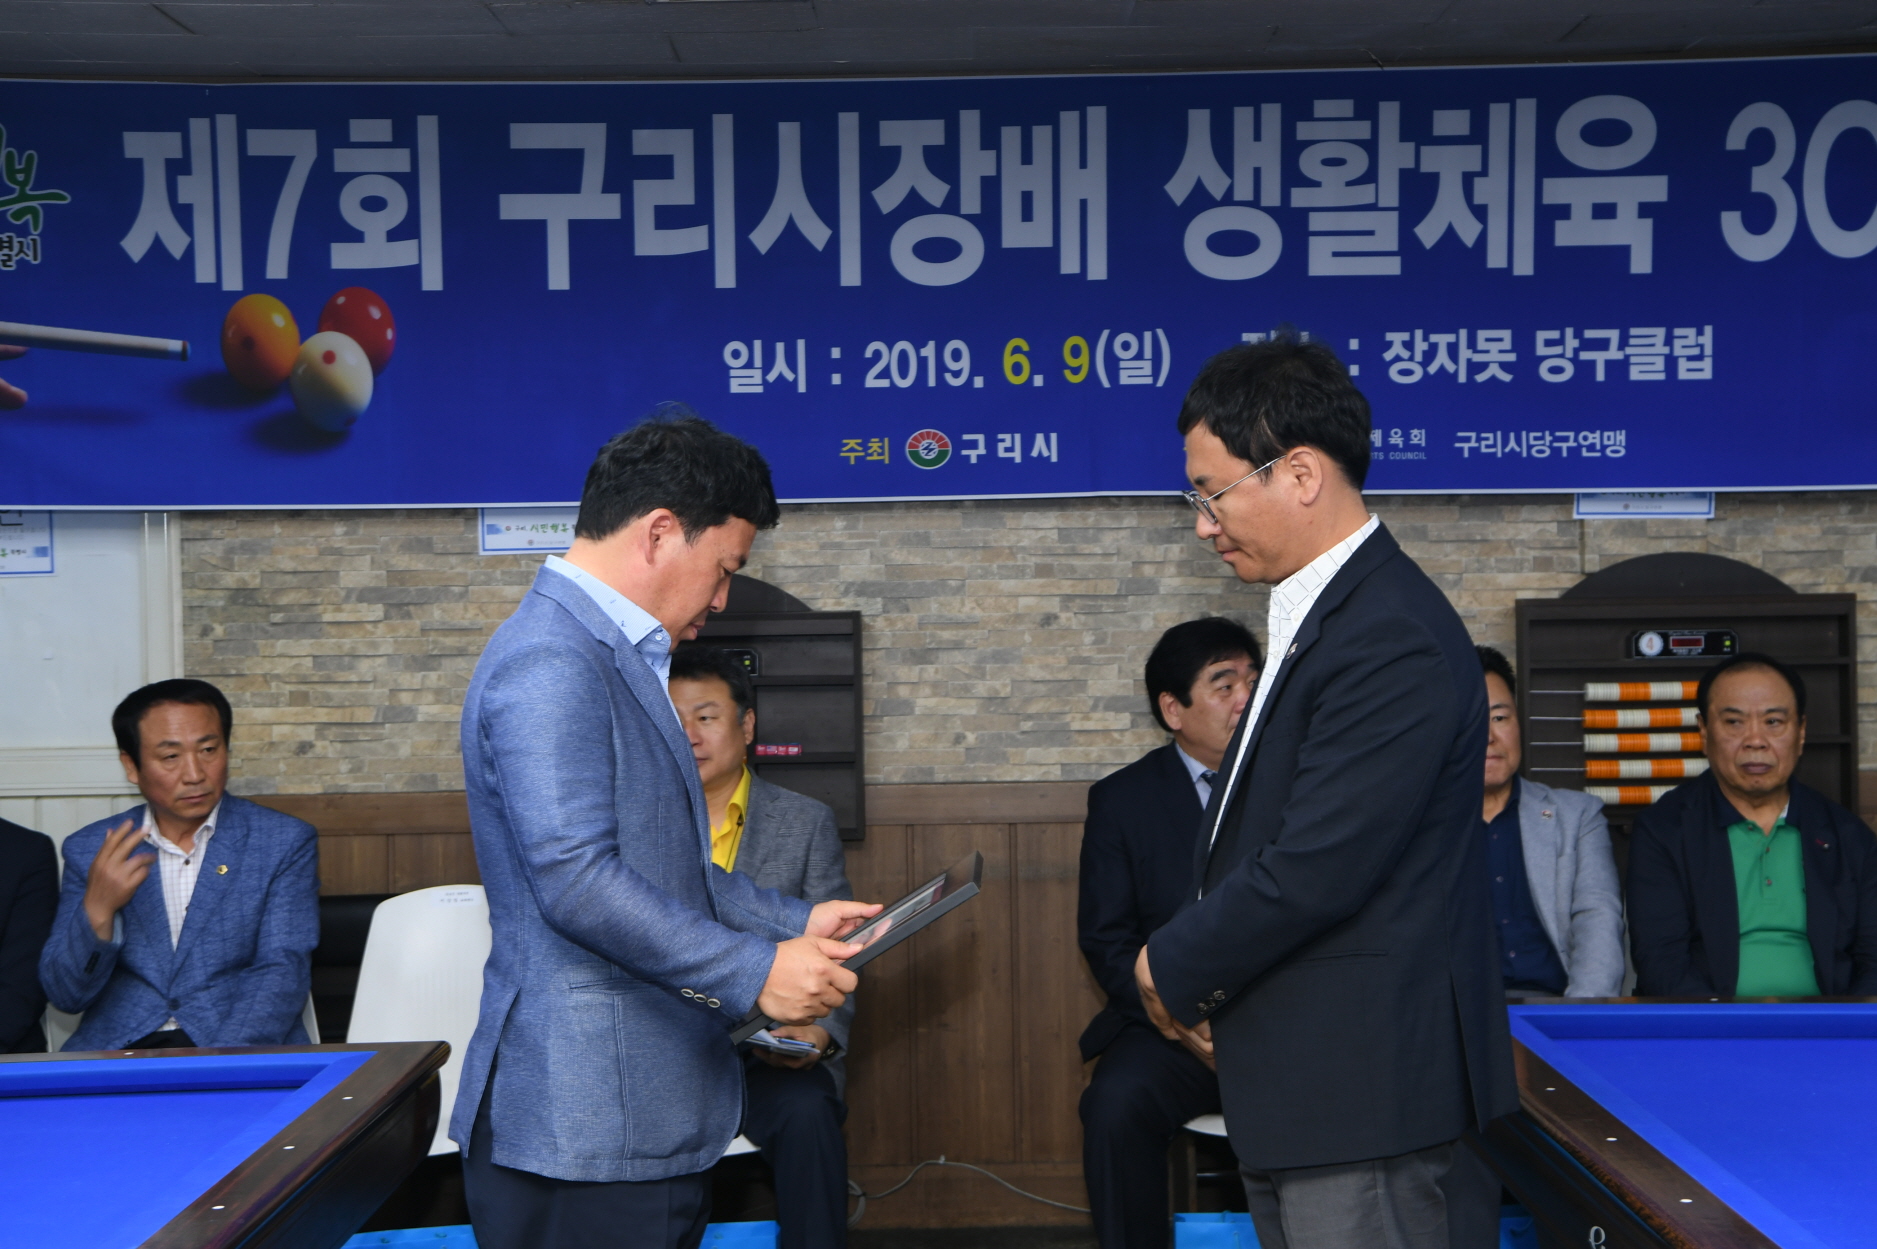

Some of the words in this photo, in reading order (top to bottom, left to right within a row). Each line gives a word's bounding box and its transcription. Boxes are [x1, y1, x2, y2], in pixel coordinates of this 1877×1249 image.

[0, 123, 71, 235] 복
[119, 112, 444, 292] 제7회
[499, 105, 1108, 290] 구리시장배
[1163, 94, 1669, 281] 생활체육
[723, 338, 807, 394] 일시
[864, 339, 984, 389] 2019.
[1003, 337, 1044, 387] 6.
[1062, 328, 1171, 388] 9(일)
[1381, 327, 1517, 384] 장자못
[1534, 324, 1714, 383] 당구클럽
[839, 437, 890, 465] 주최
[1454, 429, 1627, 458] 구리시당구연맹
[1389, 451, 1427, 460] COUNCIL
